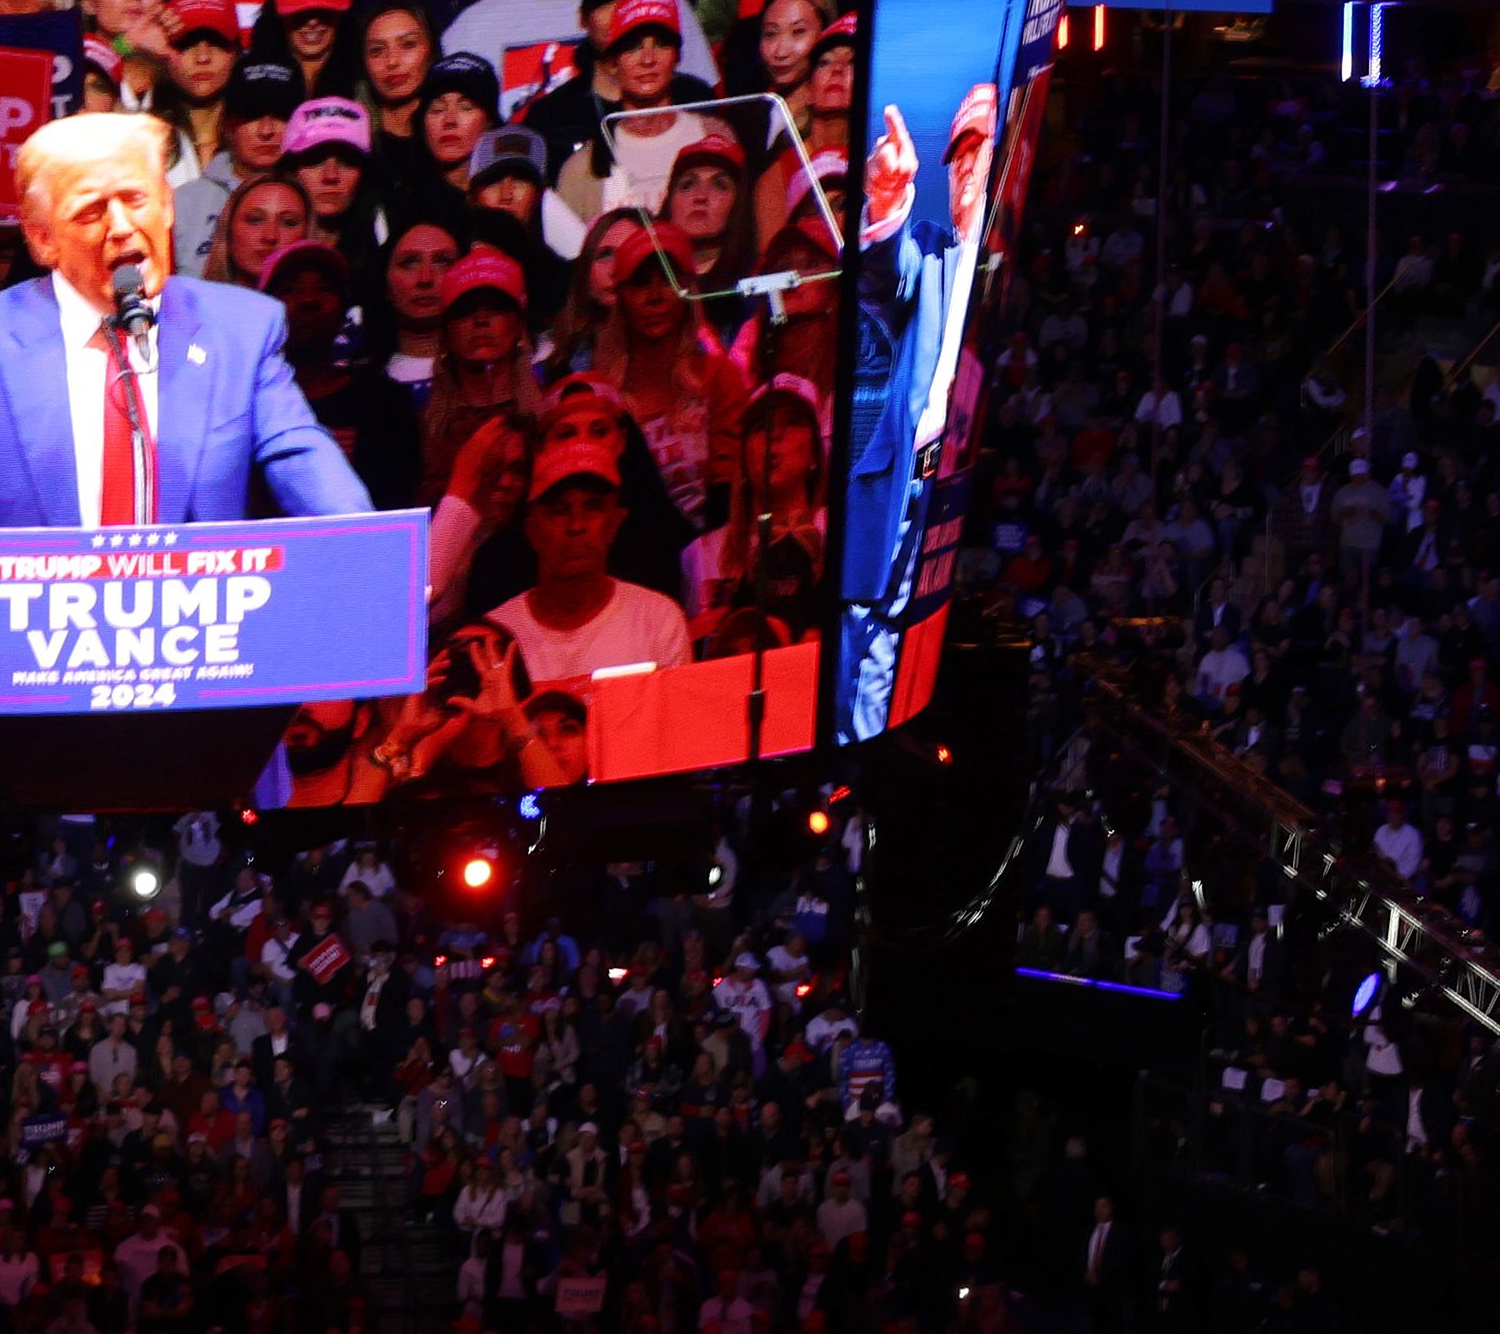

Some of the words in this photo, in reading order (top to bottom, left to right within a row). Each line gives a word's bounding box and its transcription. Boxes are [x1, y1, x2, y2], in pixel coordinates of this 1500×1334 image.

[108, 553, 184, 578] WILL
[187, 549, 237, 576] FIX
[241, 547, 273, 573] IT
[27, 623, 240, 670] VANCE
[12, 668, 60, 686] MAKE
[62, 667, 137, 686] AMERICA
[139, 666, 193, 682] GREAT
[90, 682, 177, 709] 2024
